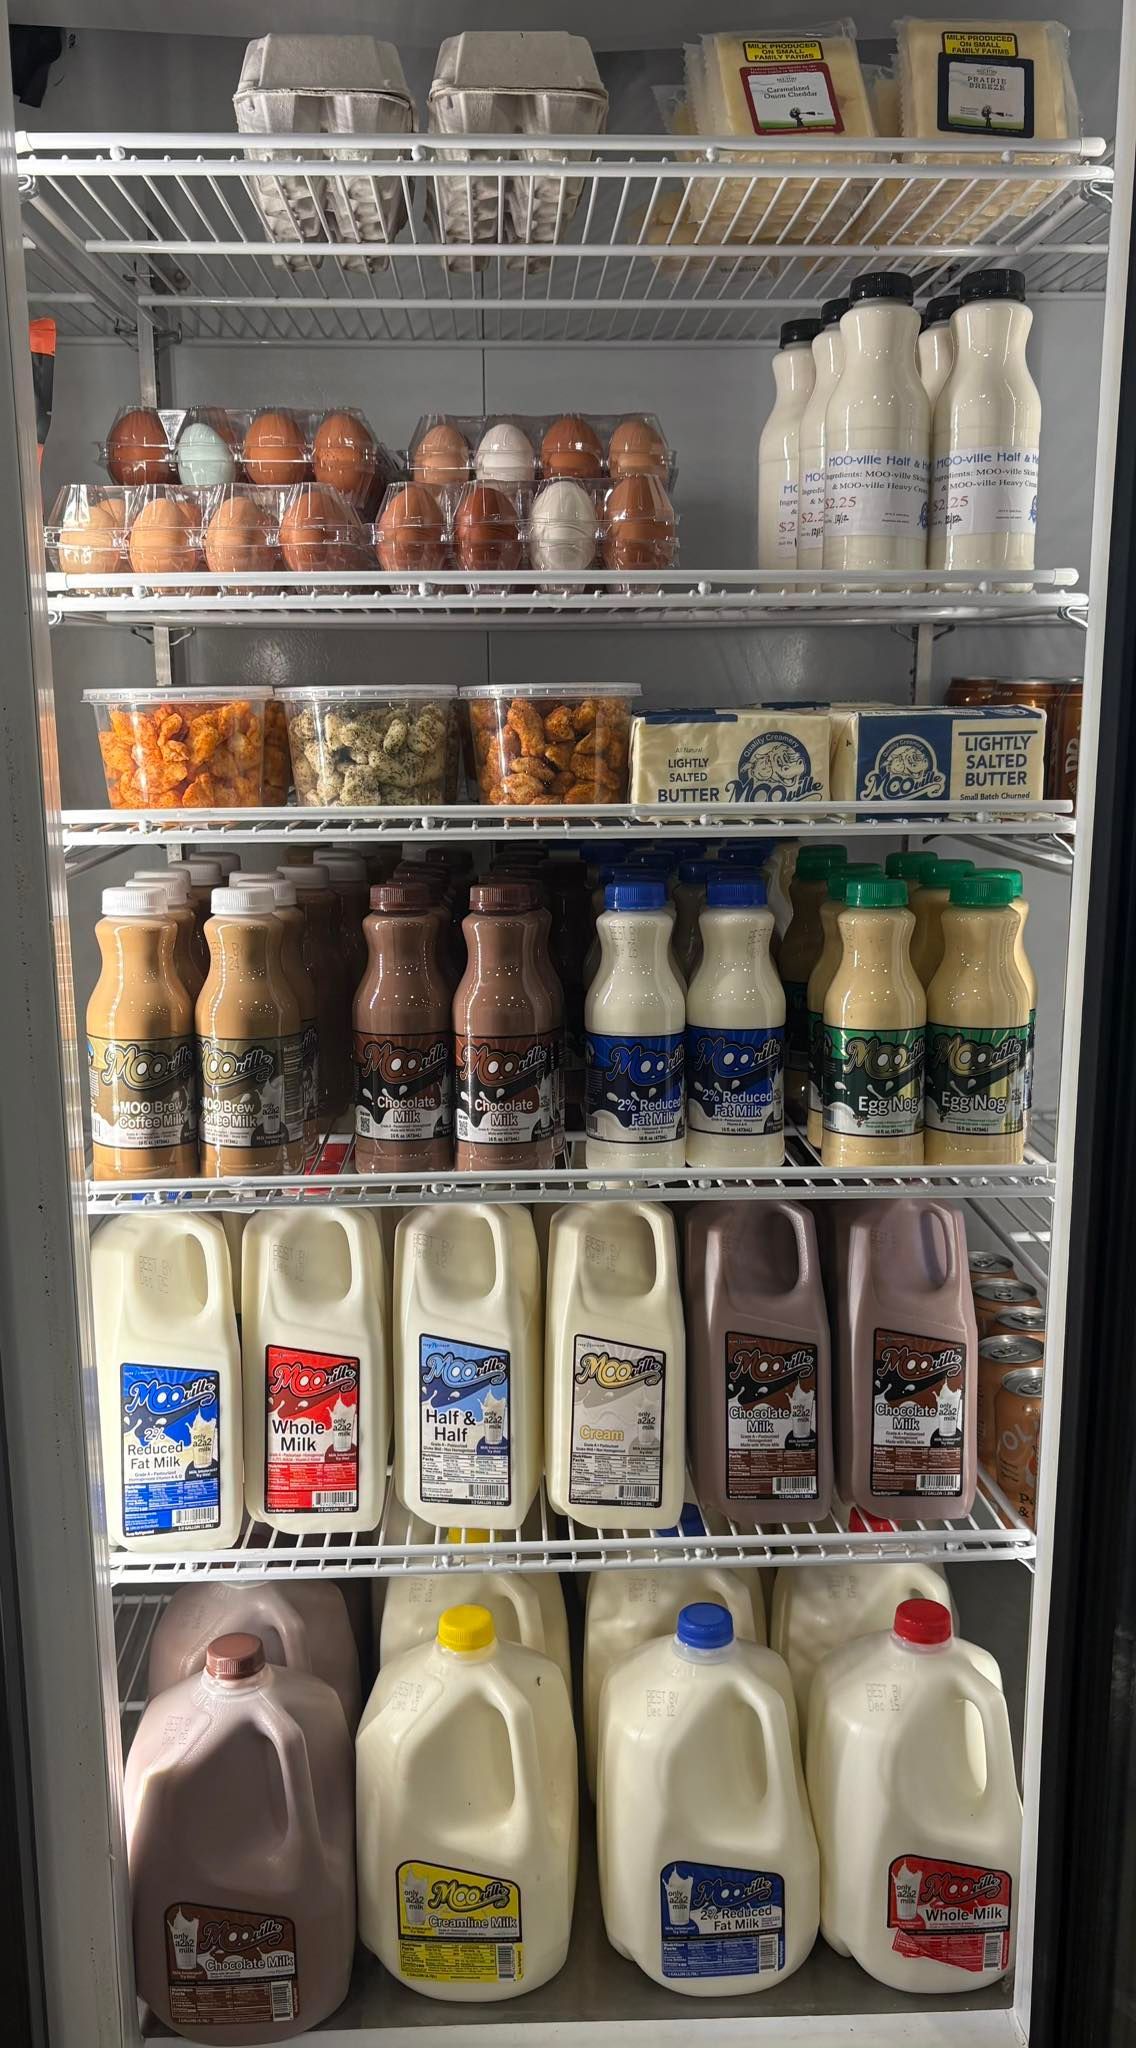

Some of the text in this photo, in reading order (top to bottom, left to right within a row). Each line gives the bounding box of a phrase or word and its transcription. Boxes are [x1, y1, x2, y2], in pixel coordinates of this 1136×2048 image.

[968, 75, 1007, 85] PRAIRIE
[969, 82, 1006, 91] BREEZE
[766, 85, 810, 93] Caramelized
[787, 90, 817, 98] Cheddar
[829, 455, 882, 468] MOO-ville
[887, 455, 911, 466] Half
[936, 452, 1031, 469] MOO-ville Half &
[976, 468, 1022, 476] MOO-ville
[887, 482, 913, 492] Heavy
[949, 479, 997, 489] MOO-ville
[999, 480, 1023, 489] Heavy
[824, 495, 857, 509] $2.25
[743, 733, 800, 758] Quality Creamery
[964, 735, 1031, 751] LIGHTLY
[668, 757, 710, 769] LIGHTLY
[966, 754, 1028, 769] SALTED
[669, 772, 708, 783] SALTED
[964, 771, 1027, 787] BUTTER
[658, 787, 720, 803] BUTTER
[960, 791, 1031, 800] Small Batch Churned
[701, 1088, 772, 1103] 2% Reduced
[941, 1091, 1007, 1113] Egg Nog
[119, 1101, 184, 1115] MOO Brew
[225, 1101, 255, 1115] Brew
[377, 1096, 435, 1110] Chocolate
[474, 1099, 533, 1114] Chocolate
[617, 1096, 682, 1111] 2% Reduced
[858, 1095, 919, 1116] Egg Nog
[393, 1110, 421, 1124] Milk
[714, 1104, 762, 1118] Fat Milk
[119, 1112, 185, 1129] Coffee Milk
[231, 1114, 257, 1129] Milk
[490, 1113, 518, 1127] Milk
[631, 1111, 675, 1126] Fat Milk
[729, 1406, 791, 1420] Chocolate
[792, 1409, 811, 1418] a2a2
[875, 1403, 937, 1417] Chocolate
[938, 1407, 957, 1416] a2a2
[426, 1409, 477, 1426] Half &
[484, 1415, 503, 1424] a2a2
[637, 1415, 656, 1425] a2a2
[892, 1418, 920, 1430] Milk
[272, 1420, 325, 1435] Whole
[333, 1423, 352, 1432] a2a2
[579, 1425, 624, 1441] Cream
[746, 1421, 774, 1433] Milk
[144, 1428, 166, 1441] 2%
[434, 1427, 468, 1442] Half
[127, 1441, 183, 1456] Reduced
[192, 1437, 212, 1447] a2a2
[281, 1437, 316, 1452] Milk
[130, 1456, 181, 1470] Fat Milk
[404, 1889, 419, 1897] only
[668, 1890, 683, 1898] only
[896, 1884, 911, 1892] only
[897, 1890, 917, 1898] a2a2
[405, 1895, 425, 1903] a2a2
[669, 1896, 689, 1904] a2a2
[700, 1906, 772, 1921] 2% Reduced
[926, 1907, 1003, 1921] Whole Milk
[428, 1915, 517, 1929] Creamline Milk
[714, 1919, 760, 1931] Fat Milk
[173, 1932, 189, 1940] only
[174, 1939, 195, 1947] a2a2
[205, 1955, 294, 1972] Chocolate Milk
